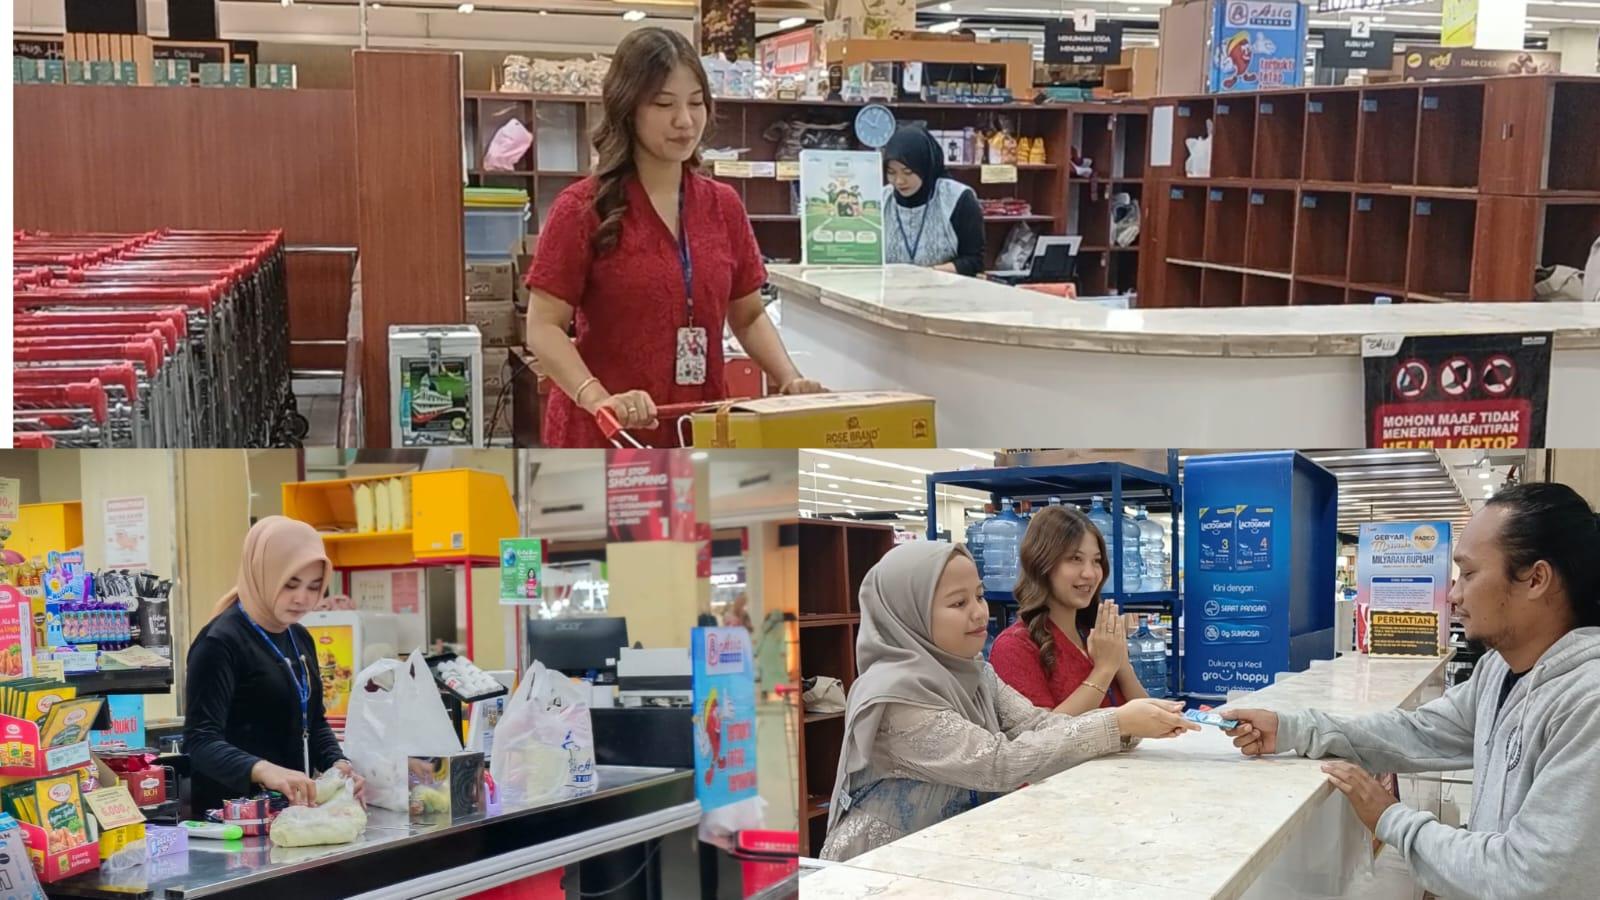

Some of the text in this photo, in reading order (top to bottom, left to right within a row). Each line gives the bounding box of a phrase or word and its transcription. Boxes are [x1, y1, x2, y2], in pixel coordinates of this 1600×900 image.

[1082, 14, 1088, 27] 1
[1356, 21, 1366, 33] 2
[1383, 410, 1521, 428] MOHON MAAF TIDAK
[826, 428, 878, 442] ROSE BRAND
[1382, 422, 1519, 440] MENERIMA PENITIPAN
[608, 474, 668, 489] SHOPPING
[659, 517, 669, 538] 1
[1221, 539, 1229, 550] 3
[1260, 537, 1268, 549] 4
[1213, 584, 1254, 594] Kini dengan
[1240, 604, 1267, 613] PANGAN
[1377, 615, 1431, 625] PERHATIAN
[555, 623, 582, 631] acer
[1208, 659, 1236, 669] Dukung
[1245, 660, 1262, 668] Kecil
[1236, 671, 1269, 684] happy
[143, 788, 158, 798] RICH
